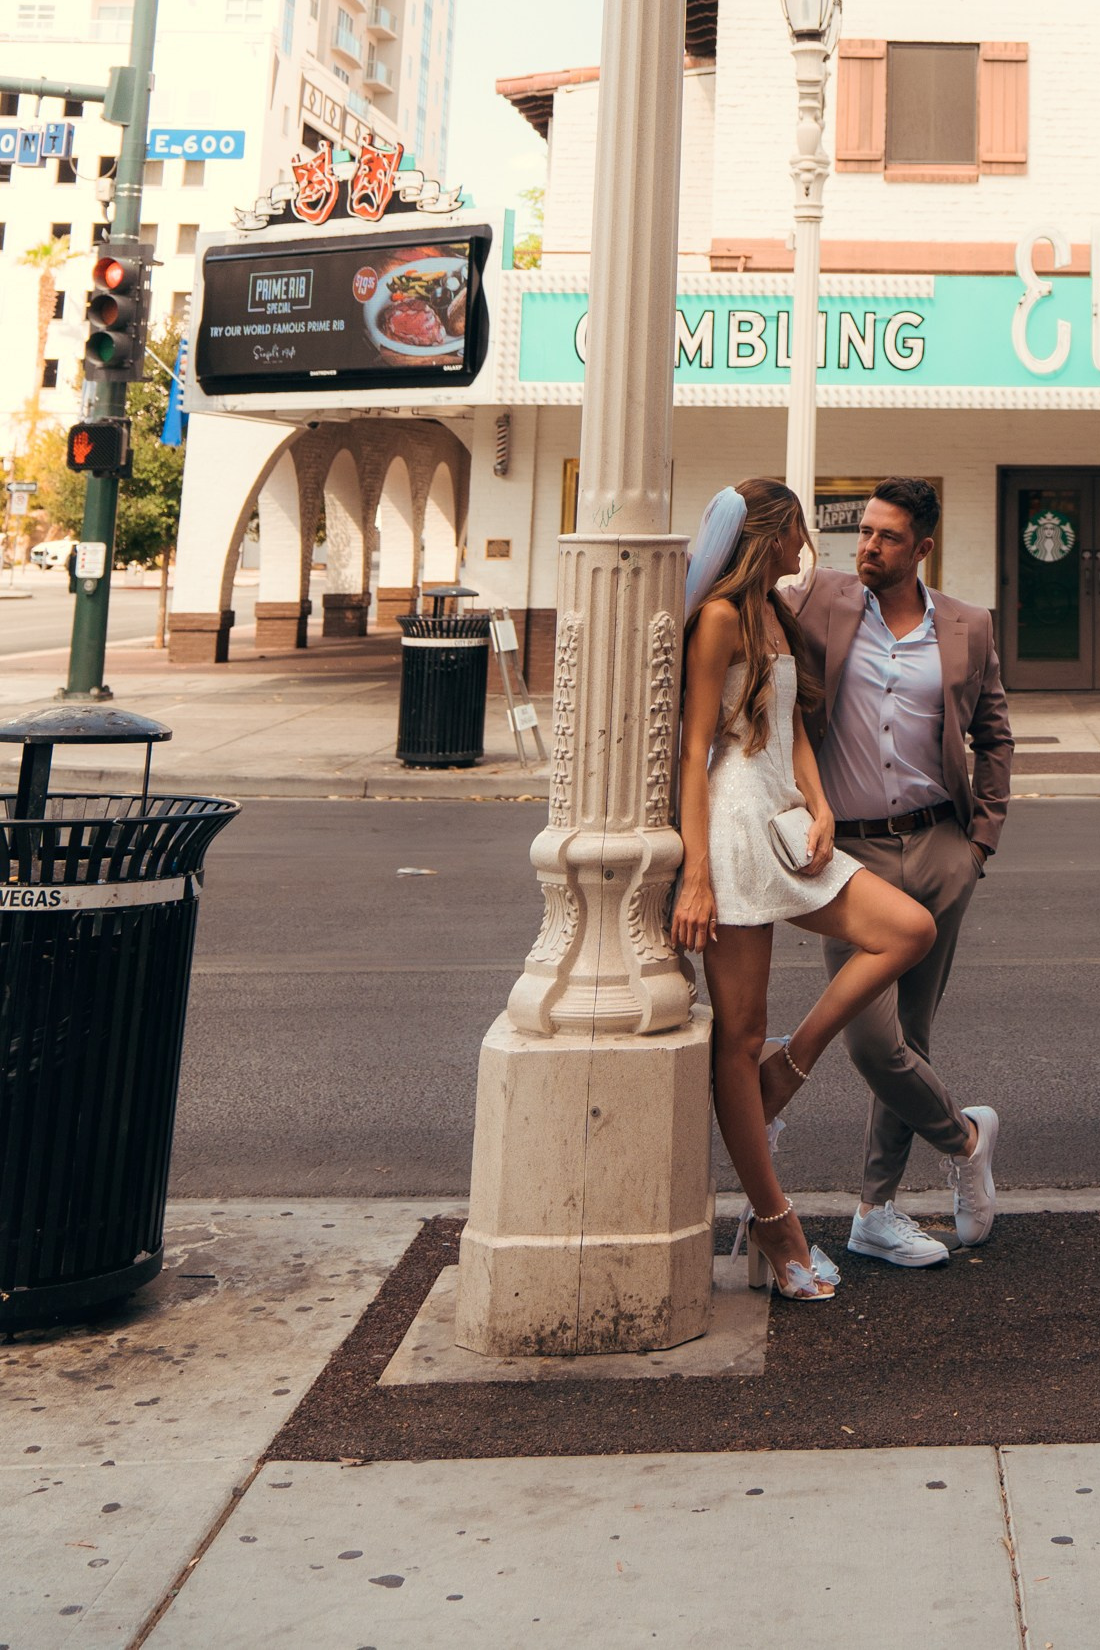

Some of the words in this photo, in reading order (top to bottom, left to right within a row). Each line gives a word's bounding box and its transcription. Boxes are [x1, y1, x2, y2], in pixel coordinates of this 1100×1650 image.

[256, 277, 287, 301] PRIME
[289, 276, 306, 300] RIB
[266, 303, 292, 314] SPECIAL
[210, 326, 223, 338] TRY
[225, 325, 242, 337] OUR
[244, 324, 271, 336] WORLD
[273, 322, 305, 335] FAMOUS
[307, 320, 330, 333] PRIME
[332, 319, 345, 331] RIB
[574, 310, 926, 372] MBLING
[0, 889, 62, 908] VEGAS
